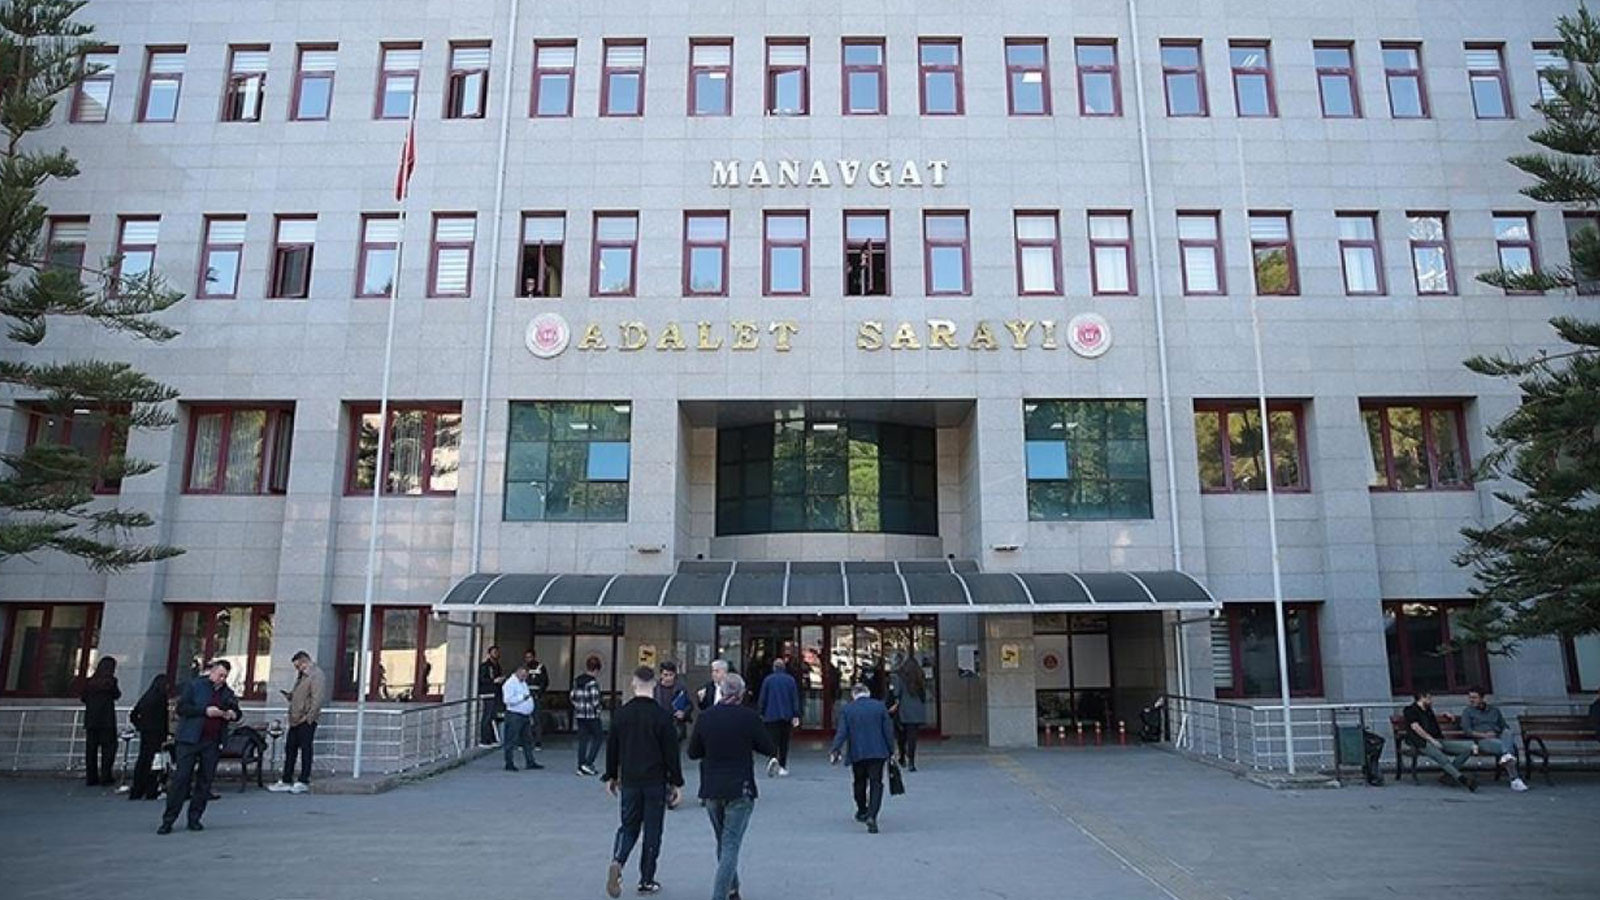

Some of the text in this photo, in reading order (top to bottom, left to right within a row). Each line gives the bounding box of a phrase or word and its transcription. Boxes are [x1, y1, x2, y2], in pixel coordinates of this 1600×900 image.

[711, 160, 949, 188] MANAVGAT
[578, 318, 1057, 351] ADALET SARAYI
